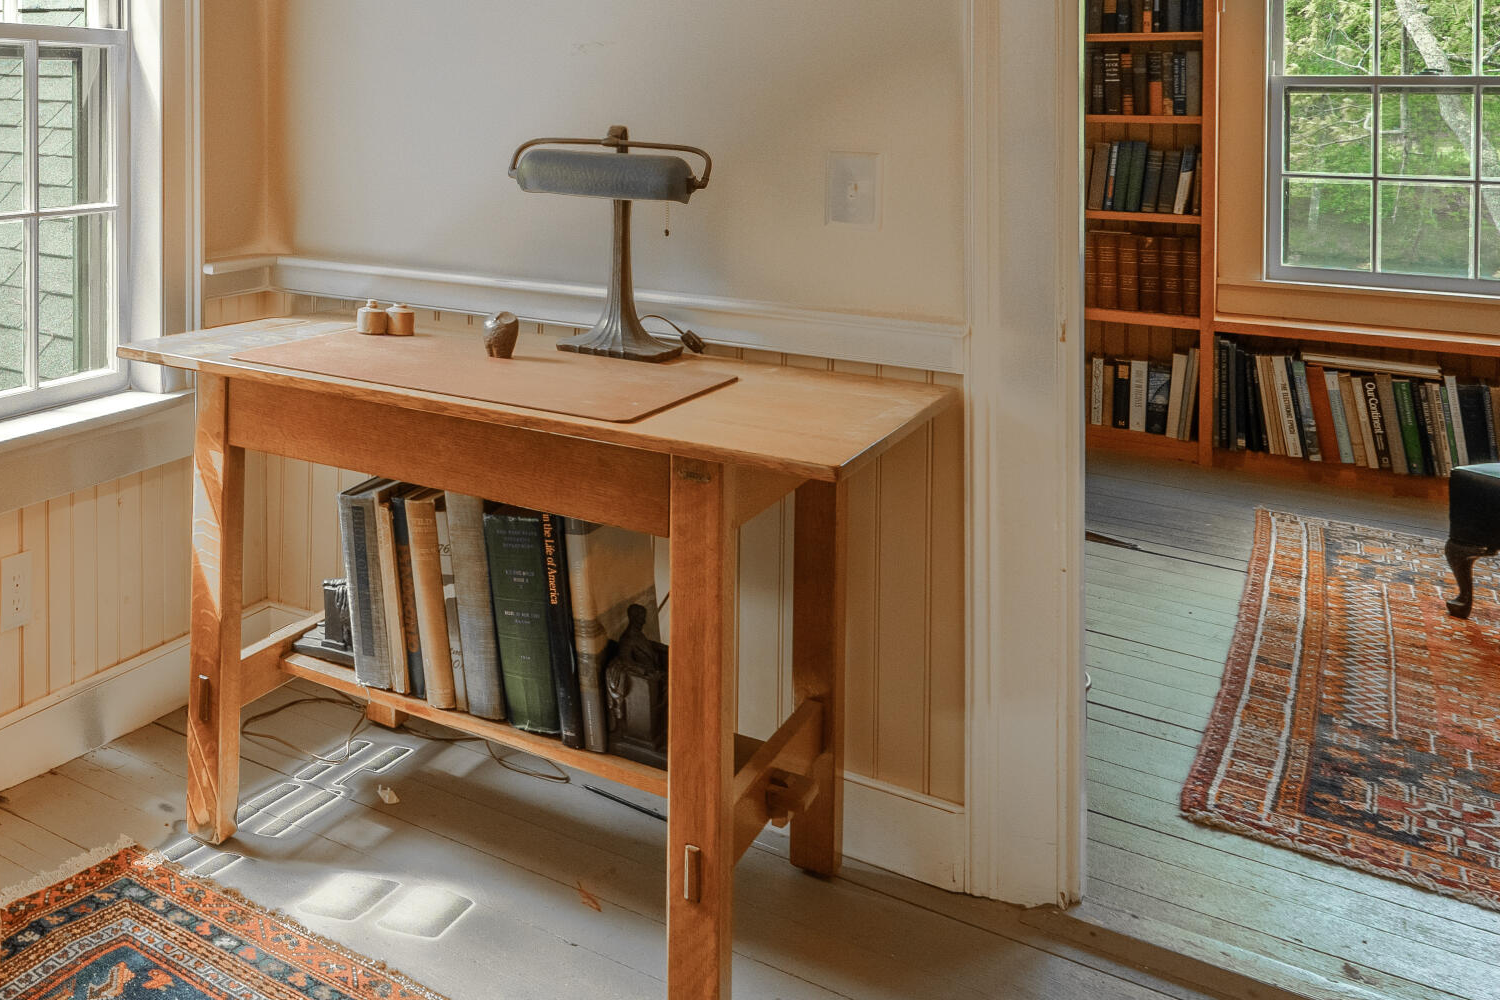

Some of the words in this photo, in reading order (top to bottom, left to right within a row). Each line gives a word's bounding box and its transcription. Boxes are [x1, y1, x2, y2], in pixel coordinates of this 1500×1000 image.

[1368, 397, 1383, 434] Continent
[544, 539, 555, 557] Life
[547, 567, 559, 605] America
